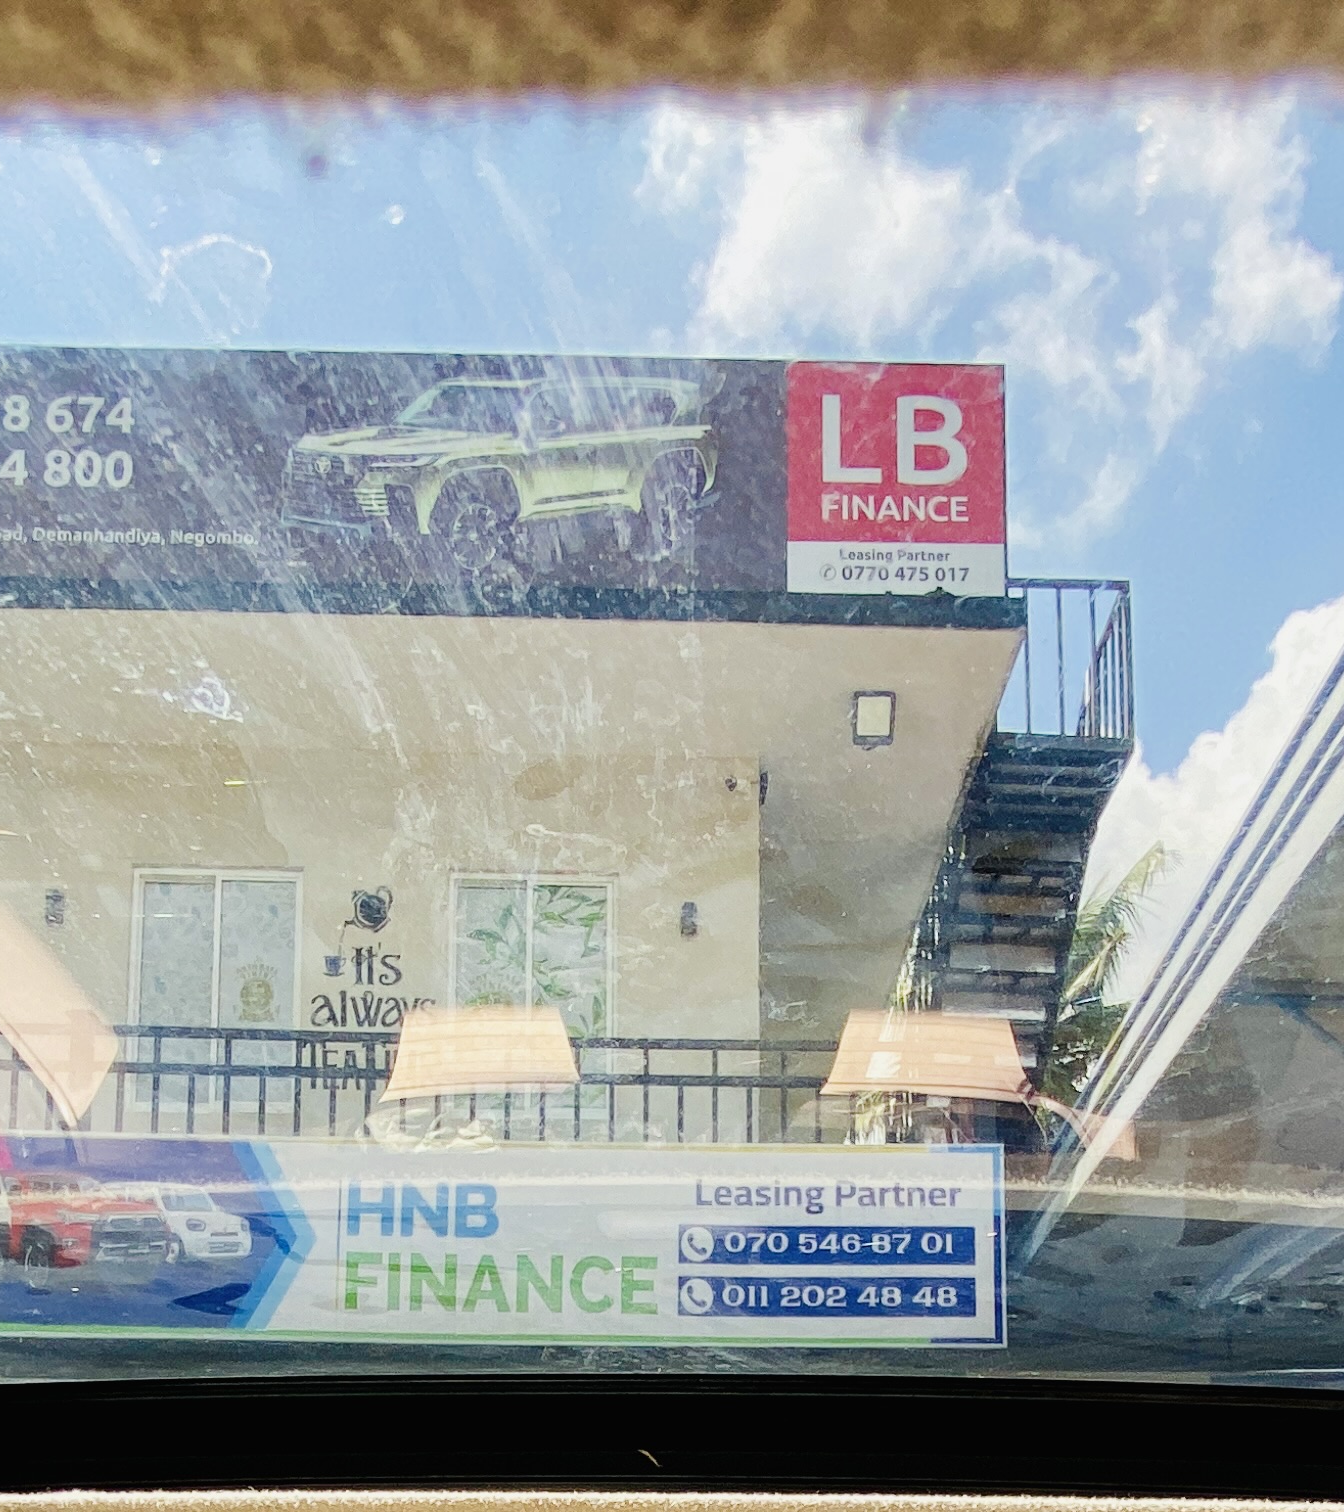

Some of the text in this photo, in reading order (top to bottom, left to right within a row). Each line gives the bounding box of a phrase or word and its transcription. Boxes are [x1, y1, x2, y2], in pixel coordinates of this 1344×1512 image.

[45, 396, 136, 434] 674
[821, 393, 969, 485] LB
[42, 449, 135, 489] 800
[820, 492, 970, 523] FINANCE
[838, 548, 951, 564] Leasing Partner
[841, 565, 970, 583] 0770 475 017
[351, 941, 404, 987] It's
[346, 1181, 500, 1239] HNB
[695, 1178, 962, 1215] Leasing Partner
[723, 1231, 790, 1255] 070
[798, 1232, 862, 1255] 546
[870, 1232, 912, 1255] 87
[344, 1250, 659, 1316] FINANCE
[721, 1284, 958, 1309] 011 202 48 48
